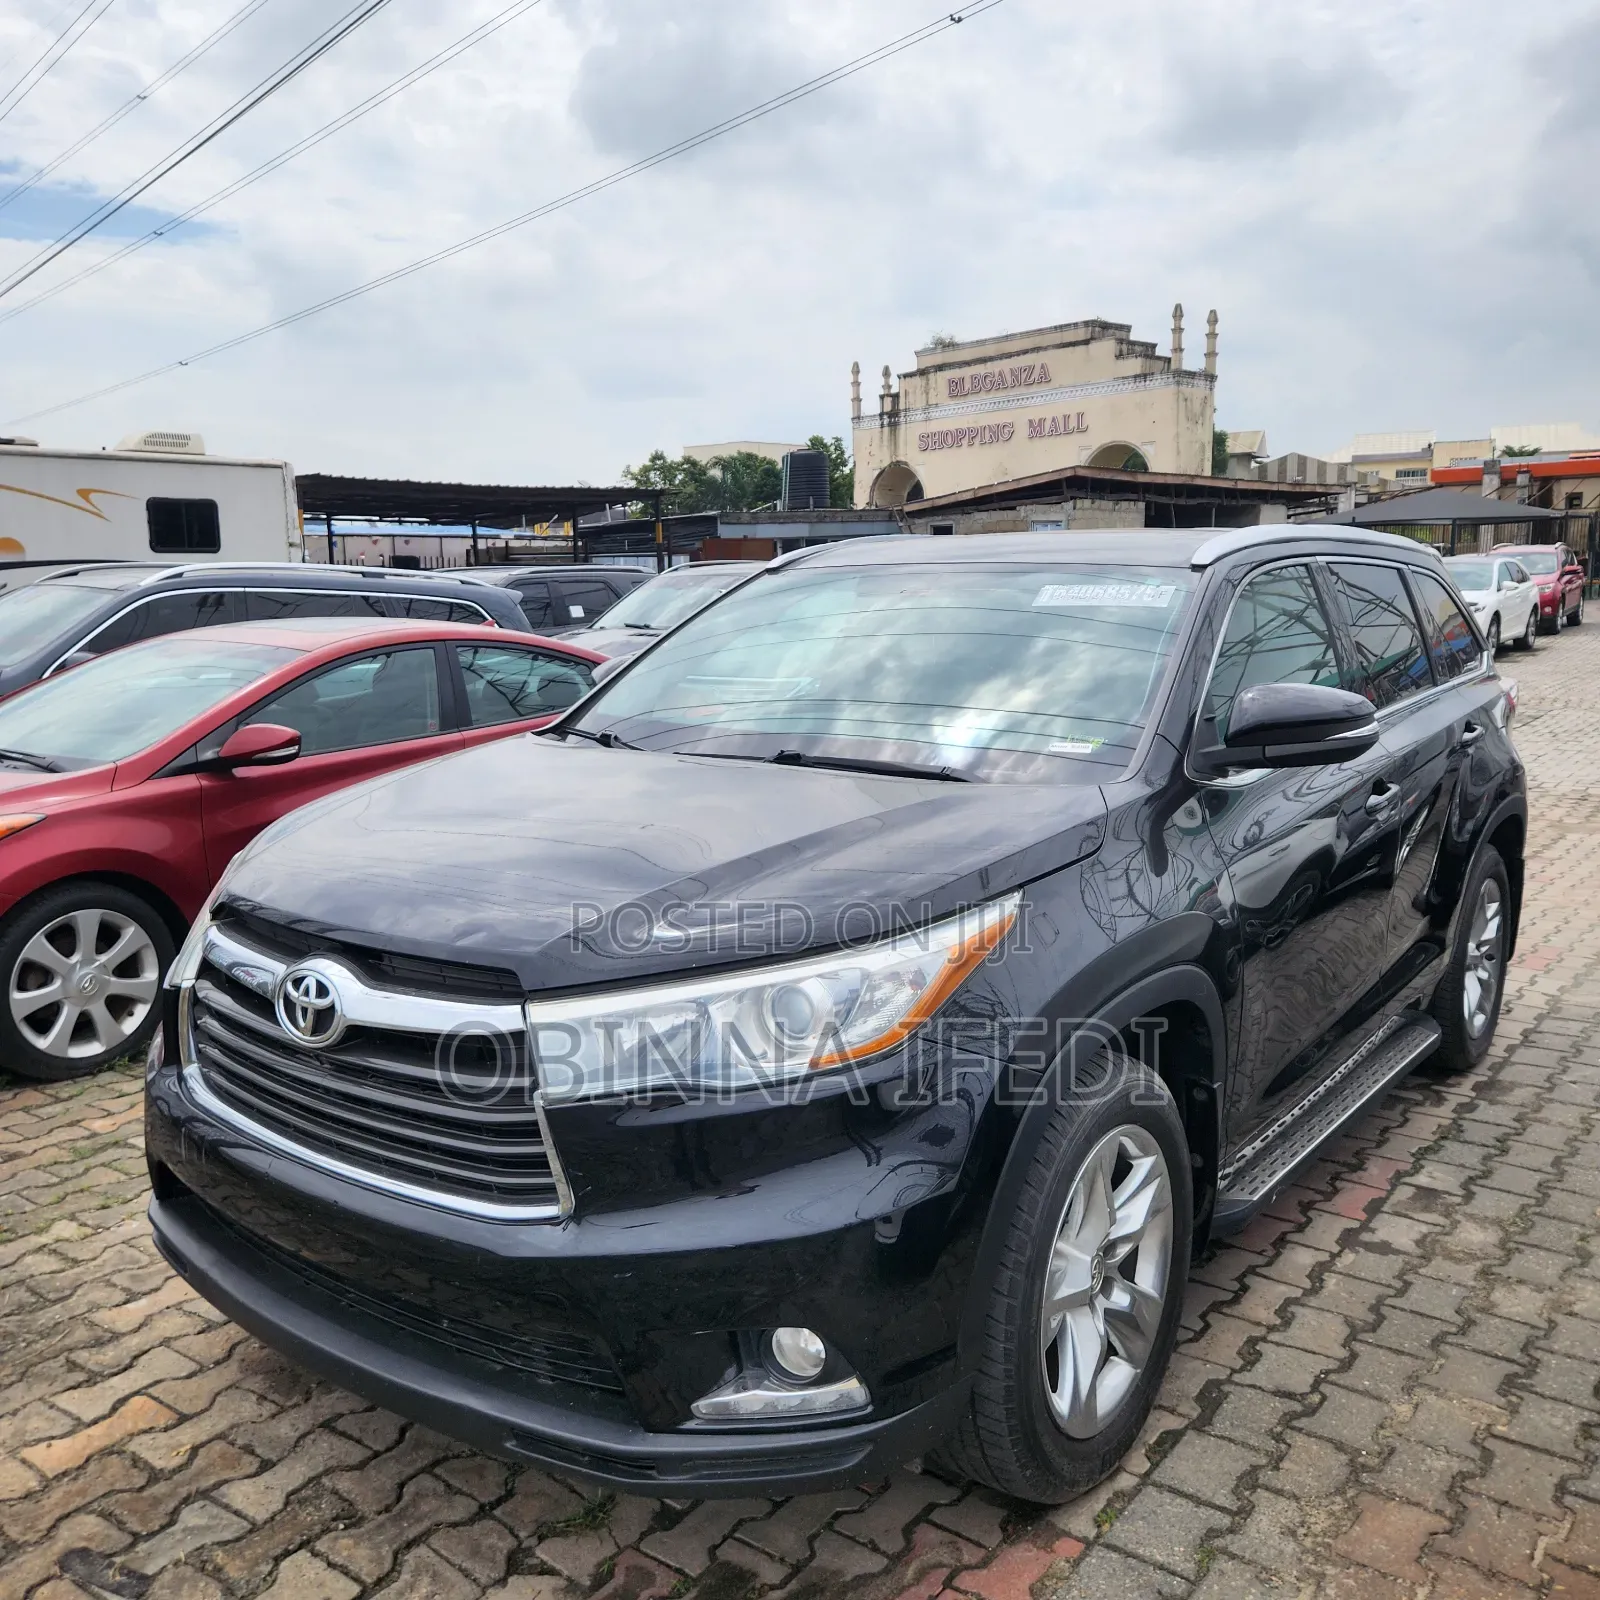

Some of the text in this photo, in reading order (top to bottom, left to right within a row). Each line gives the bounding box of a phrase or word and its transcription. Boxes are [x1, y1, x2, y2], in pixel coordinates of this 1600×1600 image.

[947, 362, 1052, 397] ELEGANZA
[918, 411, 1089, 451] SHOPPING MALL
